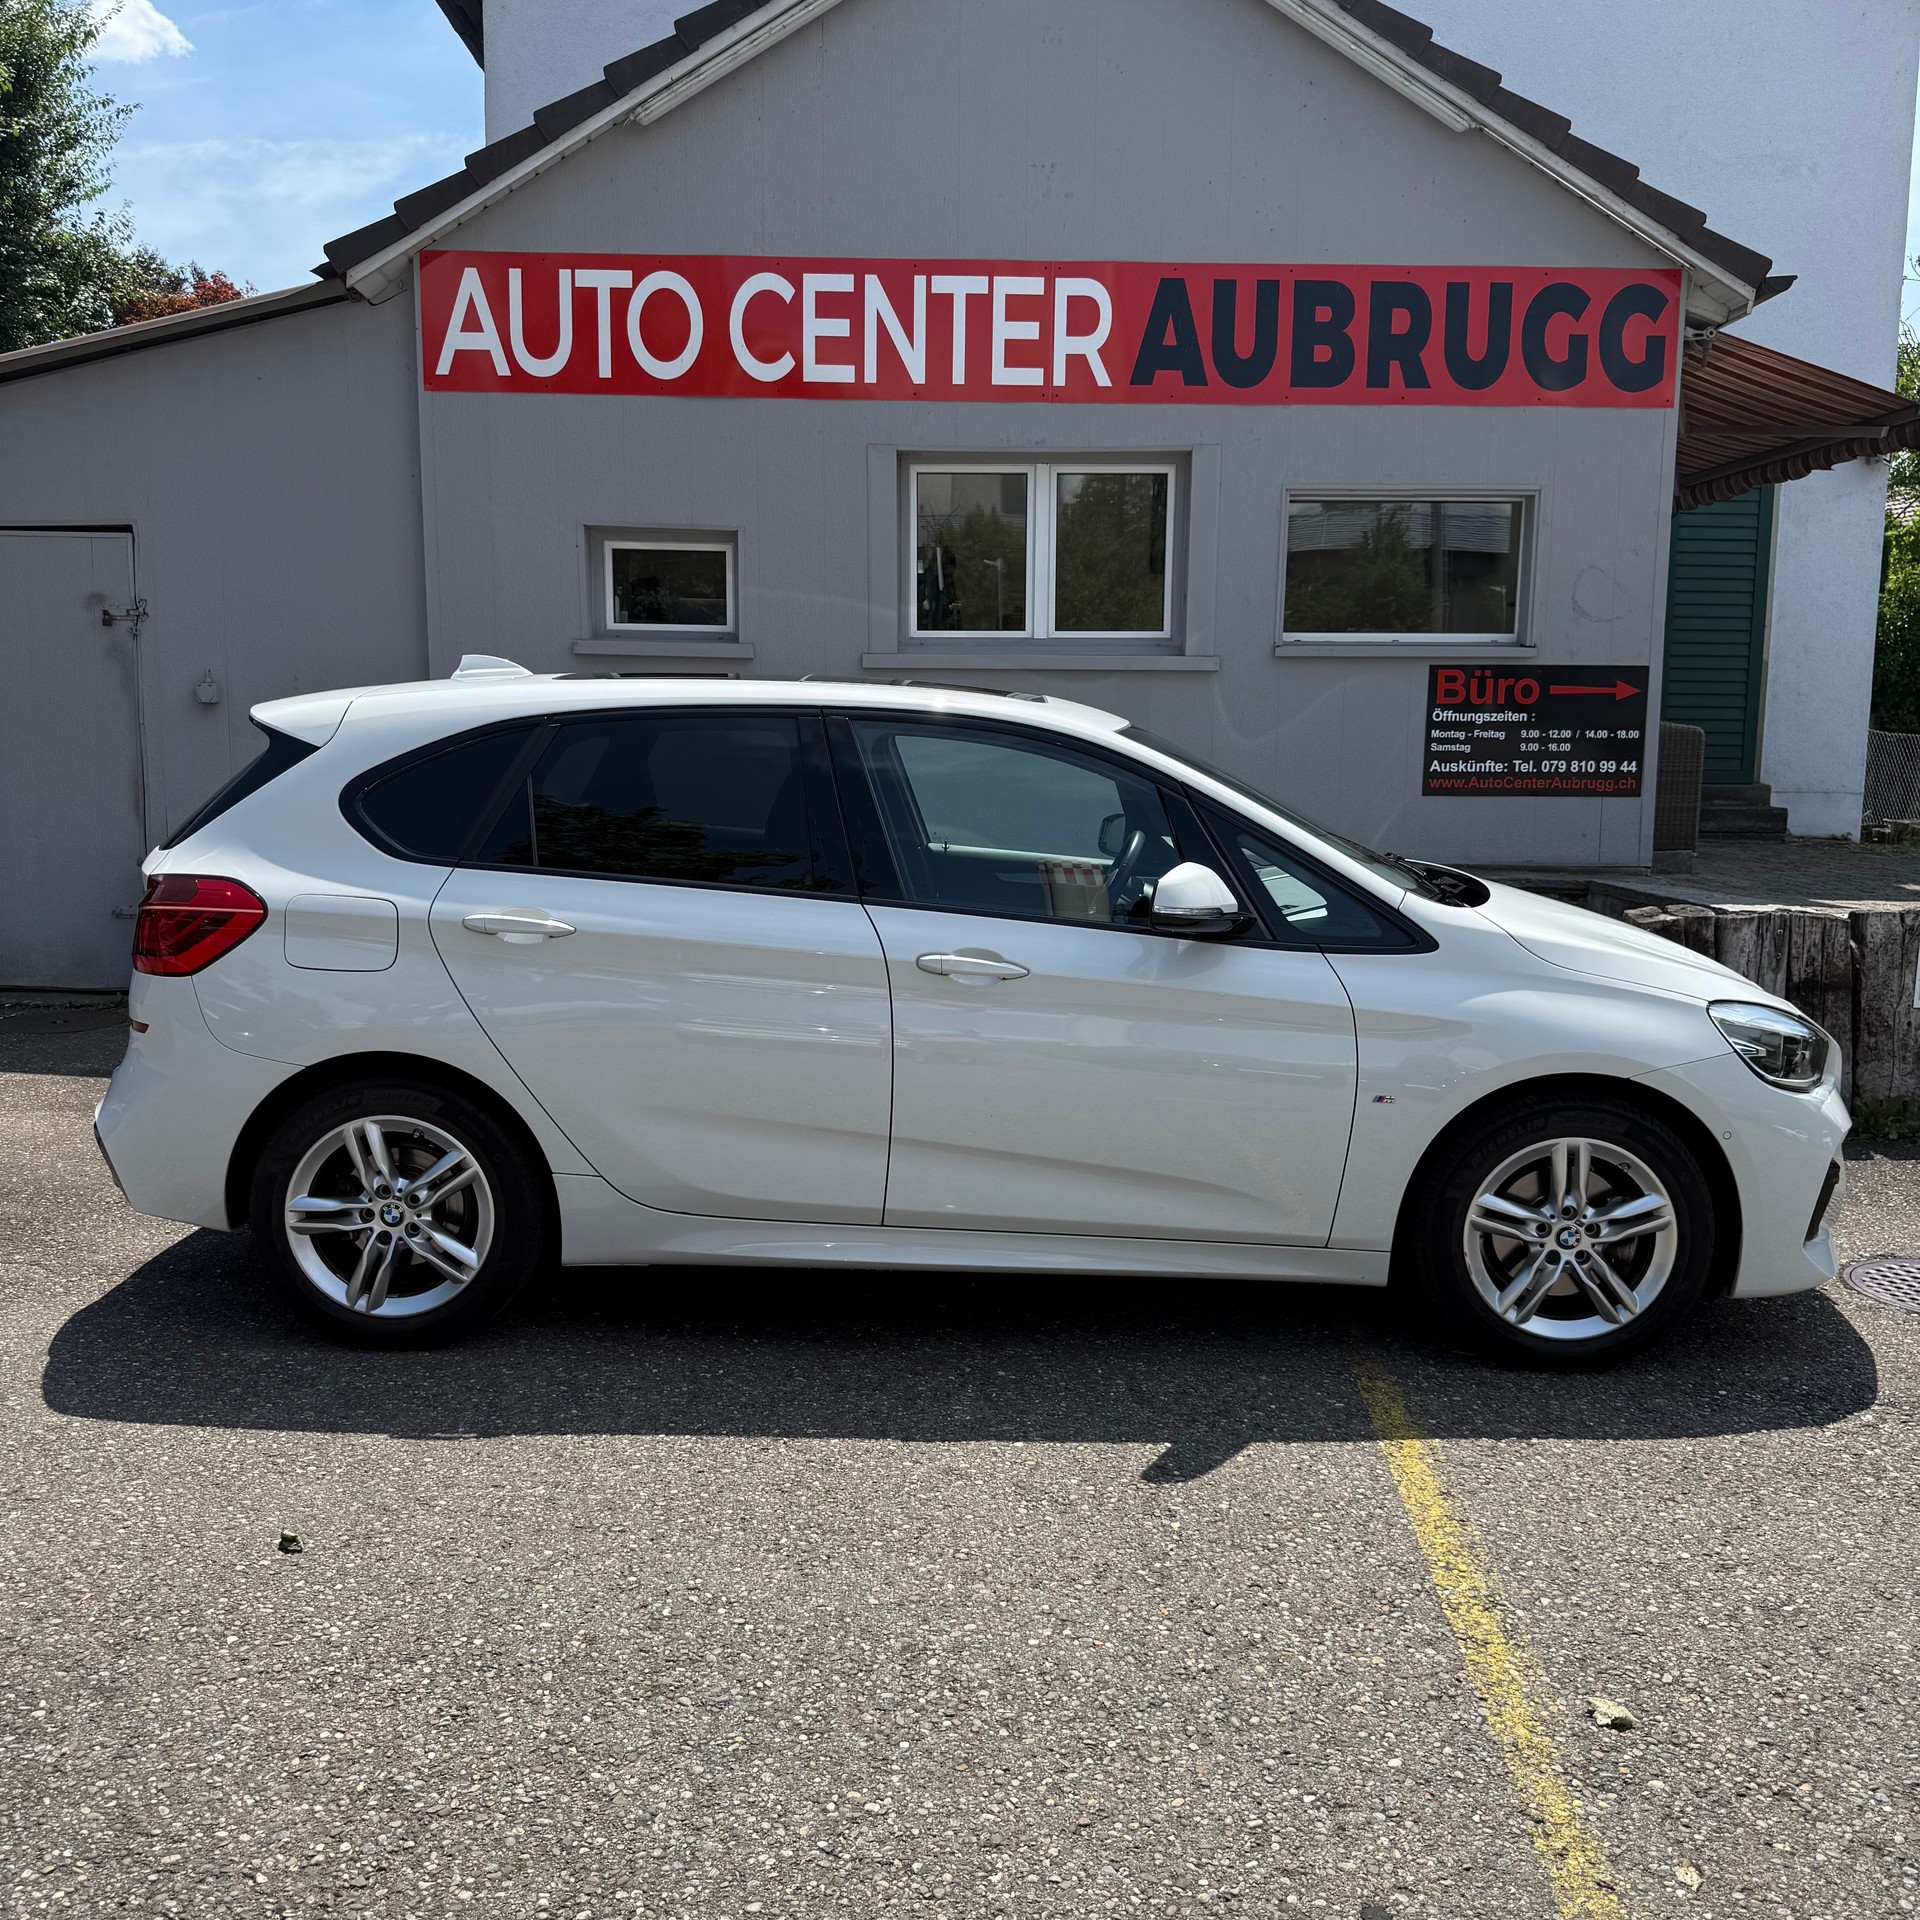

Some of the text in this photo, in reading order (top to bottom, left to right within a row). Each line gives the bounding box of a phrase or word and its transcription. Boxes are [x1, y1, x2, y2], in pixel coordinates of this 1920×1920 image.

[435, 267, 1670, 393] AUTO CENTER AUBRUGG
[1436, 668, 1540, 705] Büro
[1432, 708, 1528, 724] Öffnungszeiten
[1431, 729, 1466, 740] Montag
[1474, 729, 1506, 740] Freitag
[1520, 729, 1540, 739] 9.00
[1548, 729, 1572, 739] 12.00
[1585, 729, 1608, 739] 14.00
[1616, 729, 1640, 739] 18.00
[1430, 742, 1471, 753] Samstag
[1519, 742, 1539, 752] 9.00
[1547, 742, 1571, 752] 16.00
[1429, 760, 1637, 773] Auskünfte: Tel. 079 810 99 44
[1428, 775, 1637, 792] www.AutoCenterAubrugg.ch
